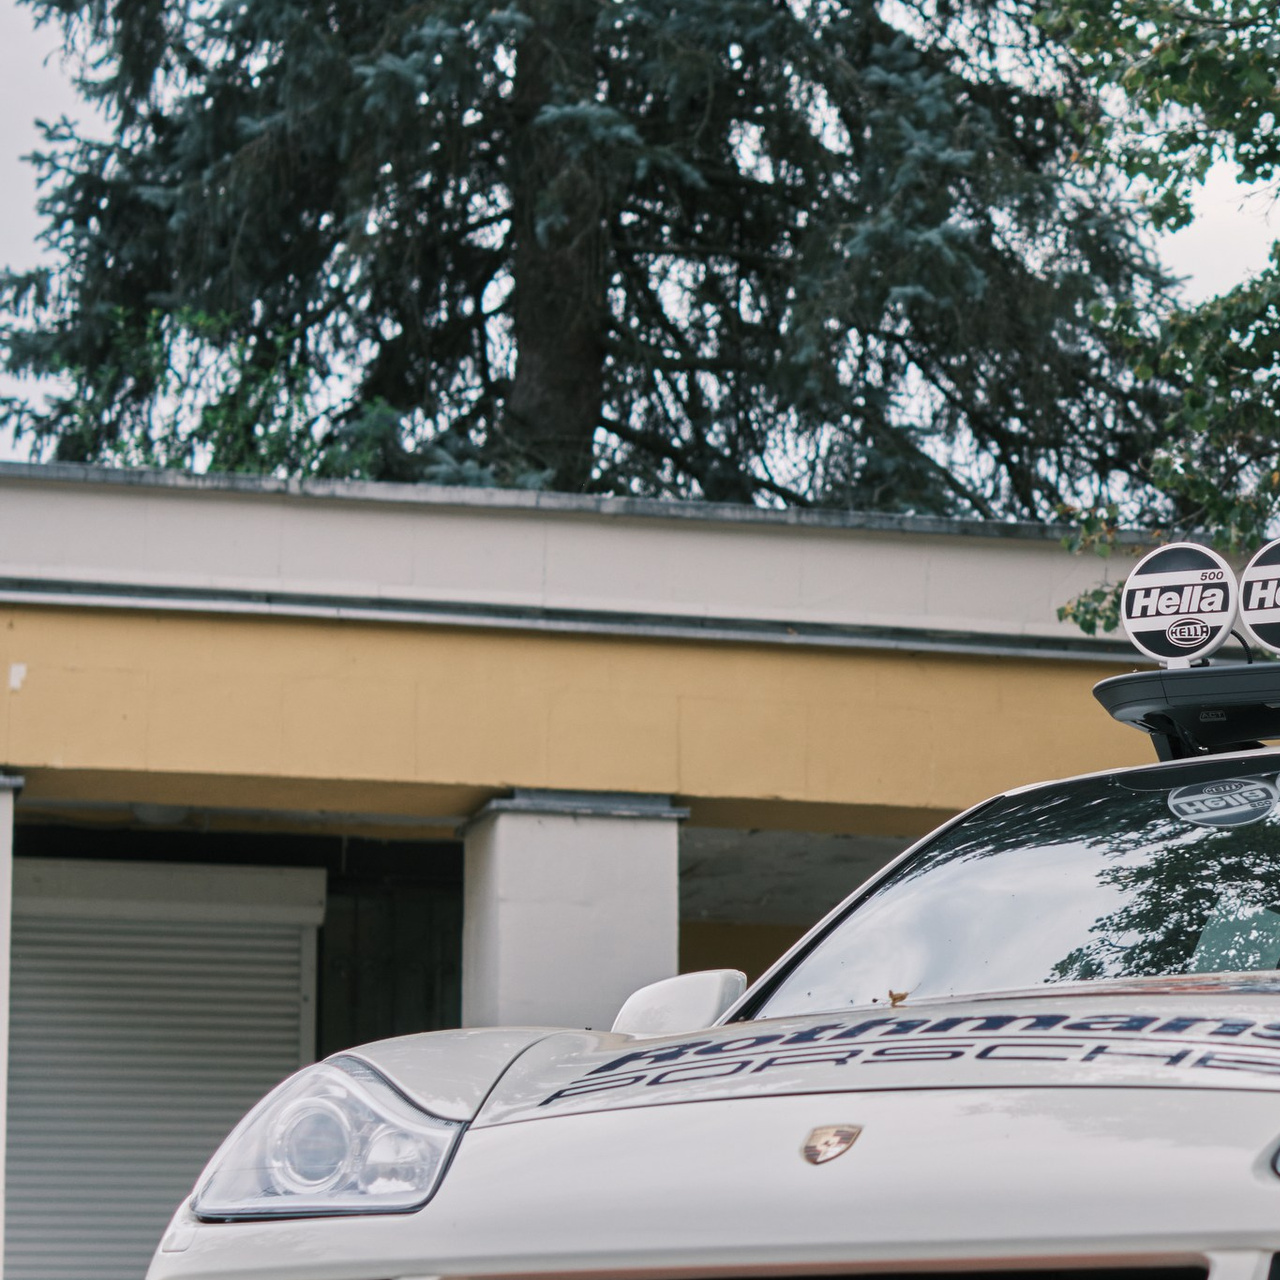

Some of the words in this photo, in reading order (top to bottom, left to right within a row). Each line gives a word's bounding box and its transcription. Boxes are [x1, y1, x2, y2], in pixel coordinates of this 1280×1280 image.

[1200, 570, 1224, 581] 500
[1130, 585, 1225, 618] Hella
[1170, 626, 1210, 639] HELLA
